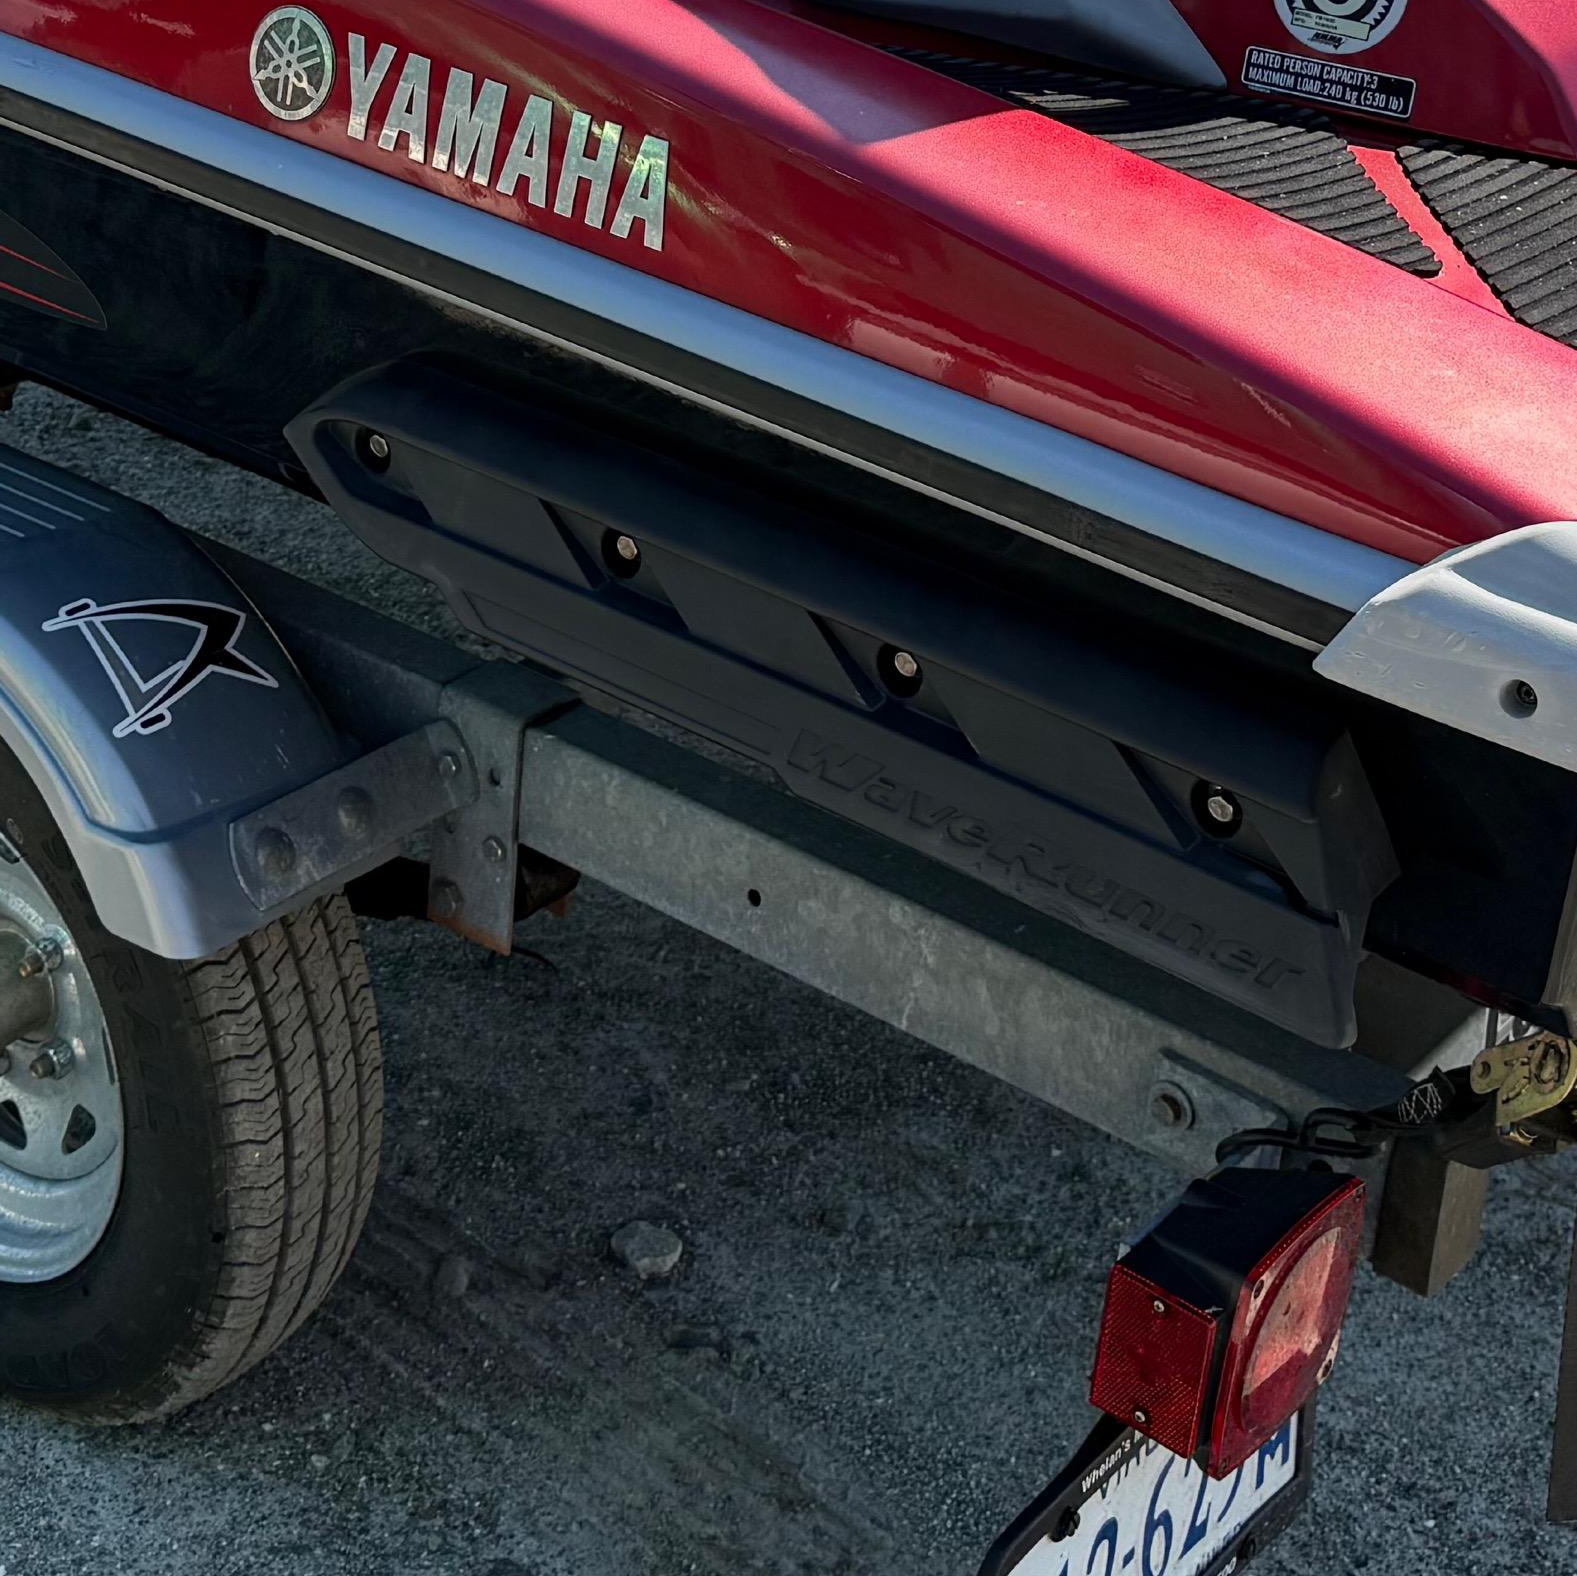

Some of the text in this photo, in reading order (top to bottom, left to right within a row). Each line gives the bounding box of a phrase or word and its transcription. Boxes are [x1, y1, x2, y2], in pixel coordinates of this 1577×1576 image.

[1248, 65, 1295, 89] MAXIMUM
[1344, 86, 1359, 106] kg
[1360, 90, 1386, 109] (530
[1387, 95, 1405, 113] lb)
[1250, 49, 1379, 90] RATED PERSON CAPACITY:3
[346, 31, 671, 252] YAMAHA
[785, 726, 1307, 991] WaveRunner
[1081, 1438, 1132, 1493] Whelan's
